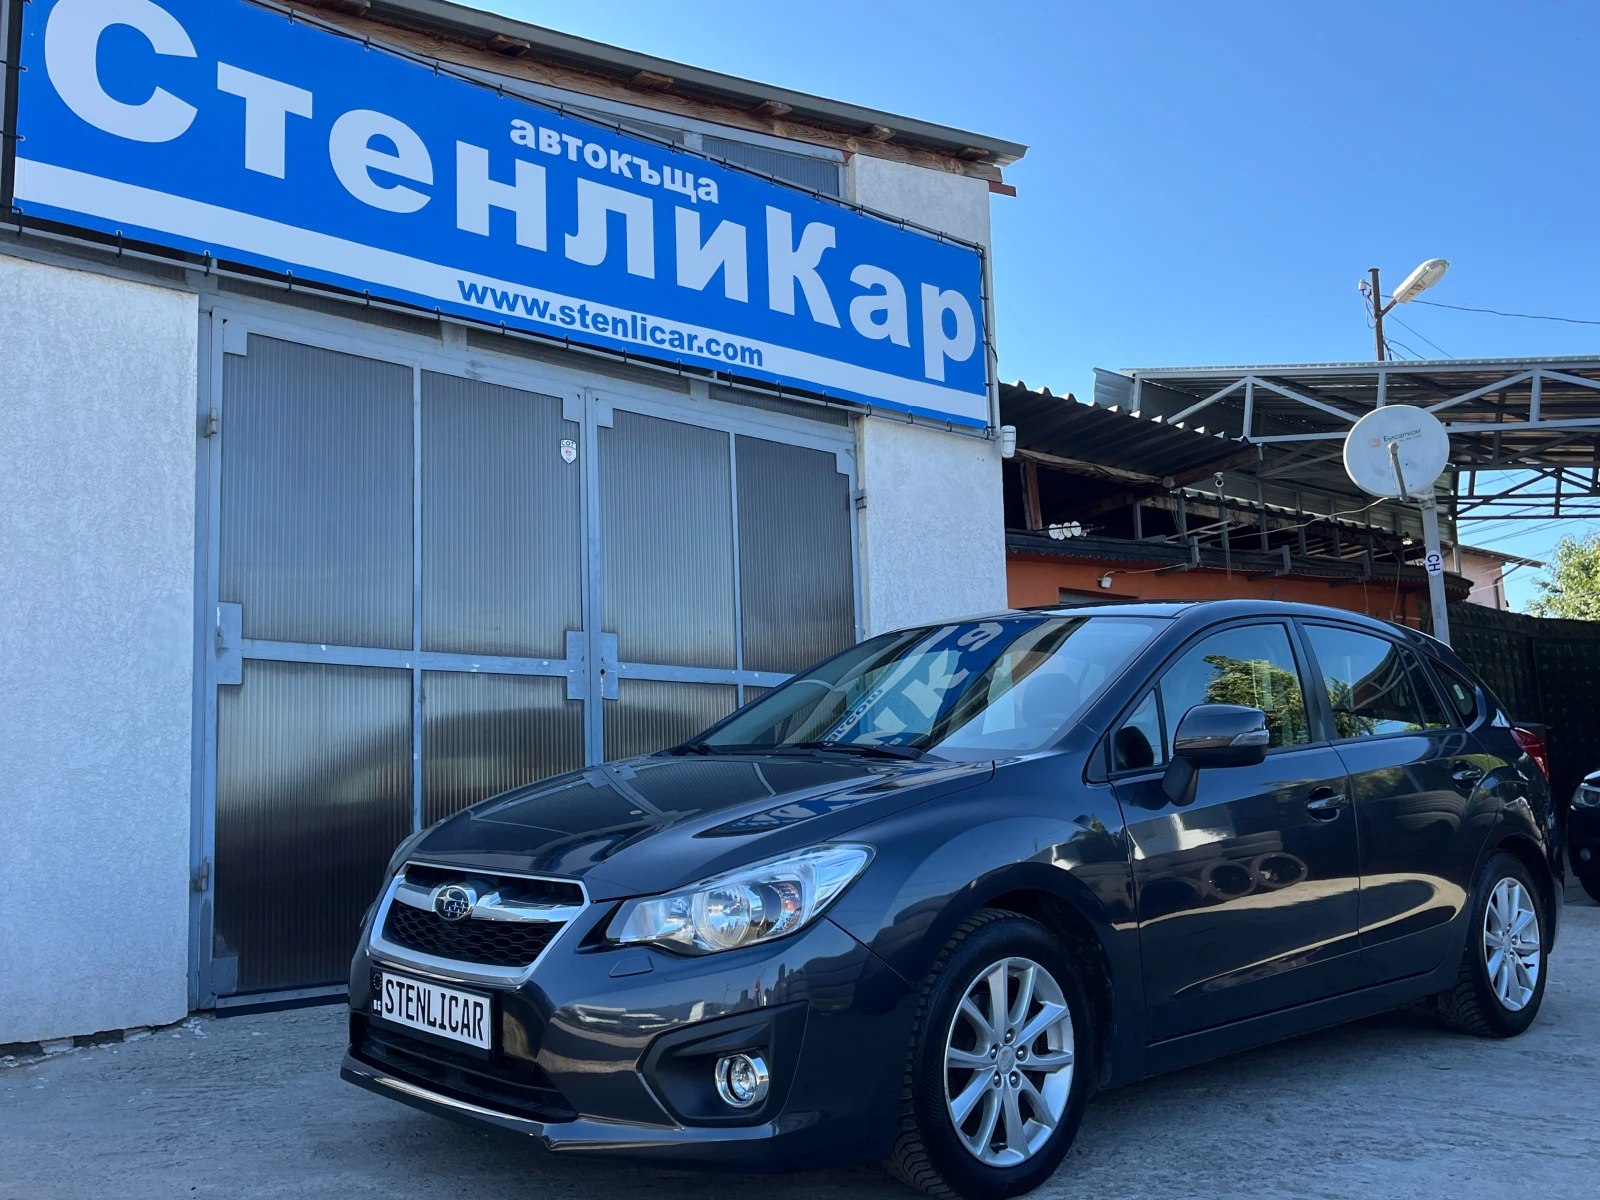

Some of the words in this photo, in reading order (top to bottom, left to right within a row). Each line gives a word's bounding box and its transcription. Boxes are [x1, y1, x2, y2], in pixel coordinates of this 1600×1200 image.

[509, 118, 719, 204] автокъща
[457, 279, 764, 368] www.stenlicar.com
[384, 978, 484, 1041] STENLICAR
